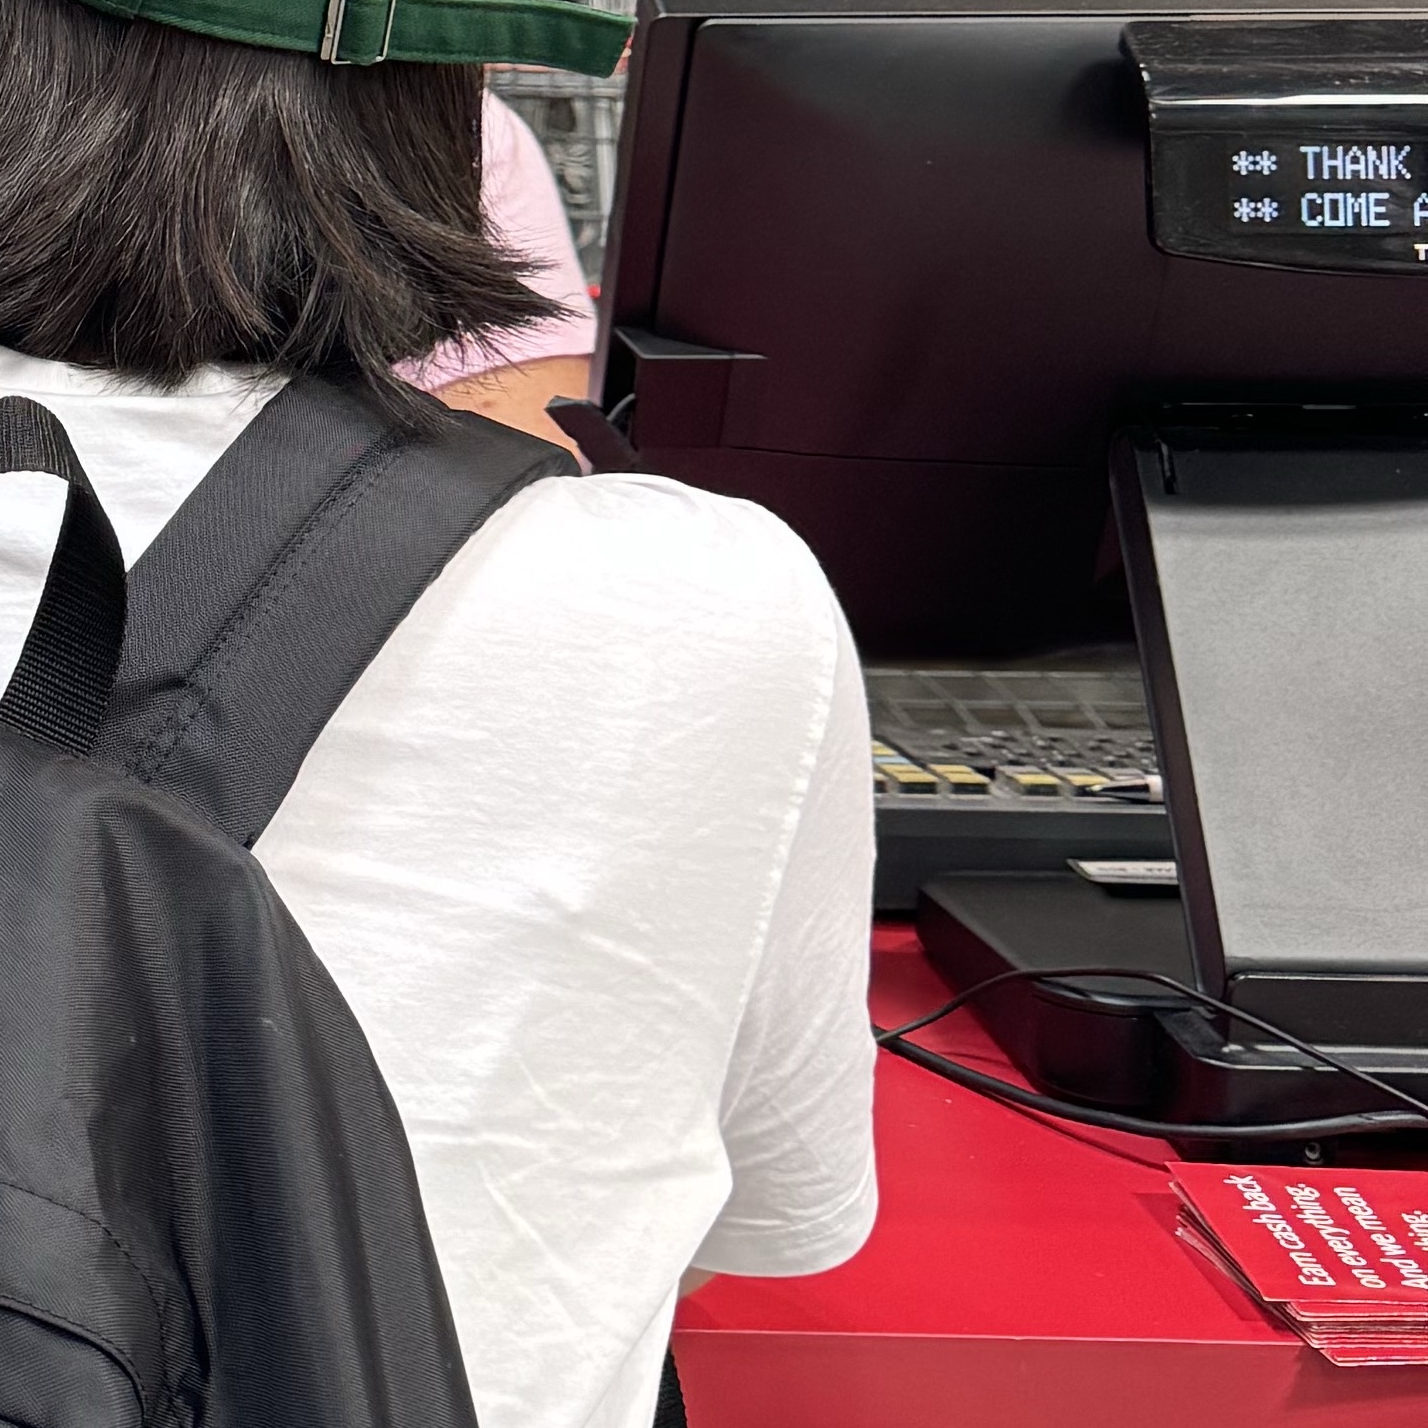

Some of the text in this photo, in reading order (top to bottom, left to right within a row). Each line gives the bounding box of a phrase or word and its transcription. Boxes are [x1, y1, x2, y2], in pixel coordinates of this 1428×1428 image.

[1299, 145, 1412, 180] THANK
[1300, 192, 1391, 227] COME
[1223, 1174, 1337, 1286] Earn cash back
[1284, 1183, 1388, 1290] on everything.
[1333, 1186, 1428, 1290] And we mean
